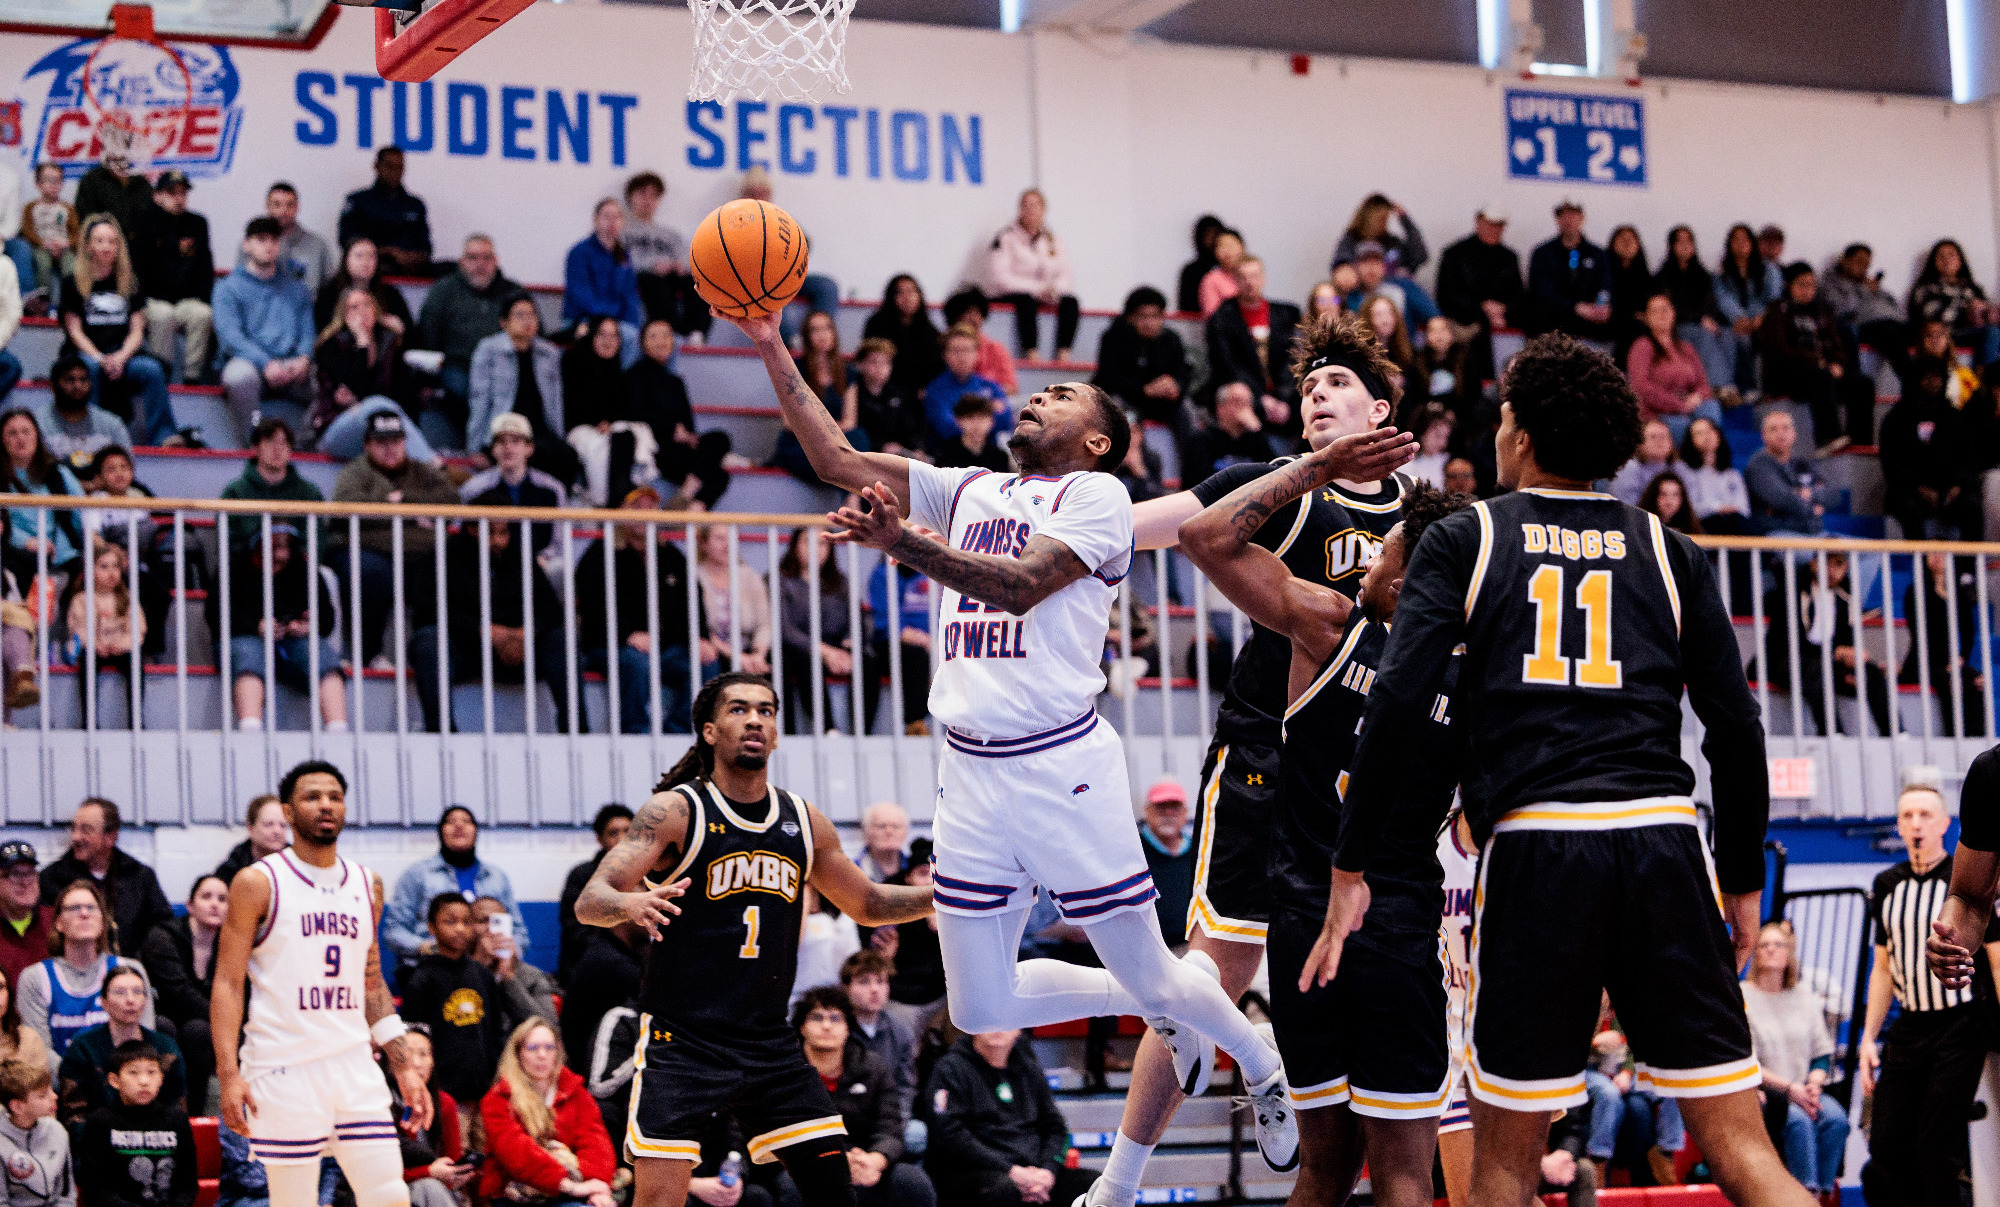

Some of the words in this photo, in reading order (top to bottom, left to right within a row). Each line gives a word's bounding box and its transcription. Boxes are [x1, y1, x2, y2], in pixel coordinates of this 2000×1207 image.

[294, 71, 638, 167] STUDENT
[686, 98, 983, 184] SECTION
[1511, 98, 1577, 124] UPPER
[1580, 101, 1638, 130] LEVEL
[1536, 126, 1565, 176] 1
[1587, 129, 1616, 179] 2
[960, 517, 1031, 560] UMASS
[1522, 523, 1627, 561] DIGGS
[944, 620, 1028, 661] LOWELL
[1522, 564, 1623, 689] 11
[707, 851, 800, 902] UMBC
[301, 911, 359, 940] UMASS
[739, 906, 760, 959] 1
[325, 944, 341, 977] 9
